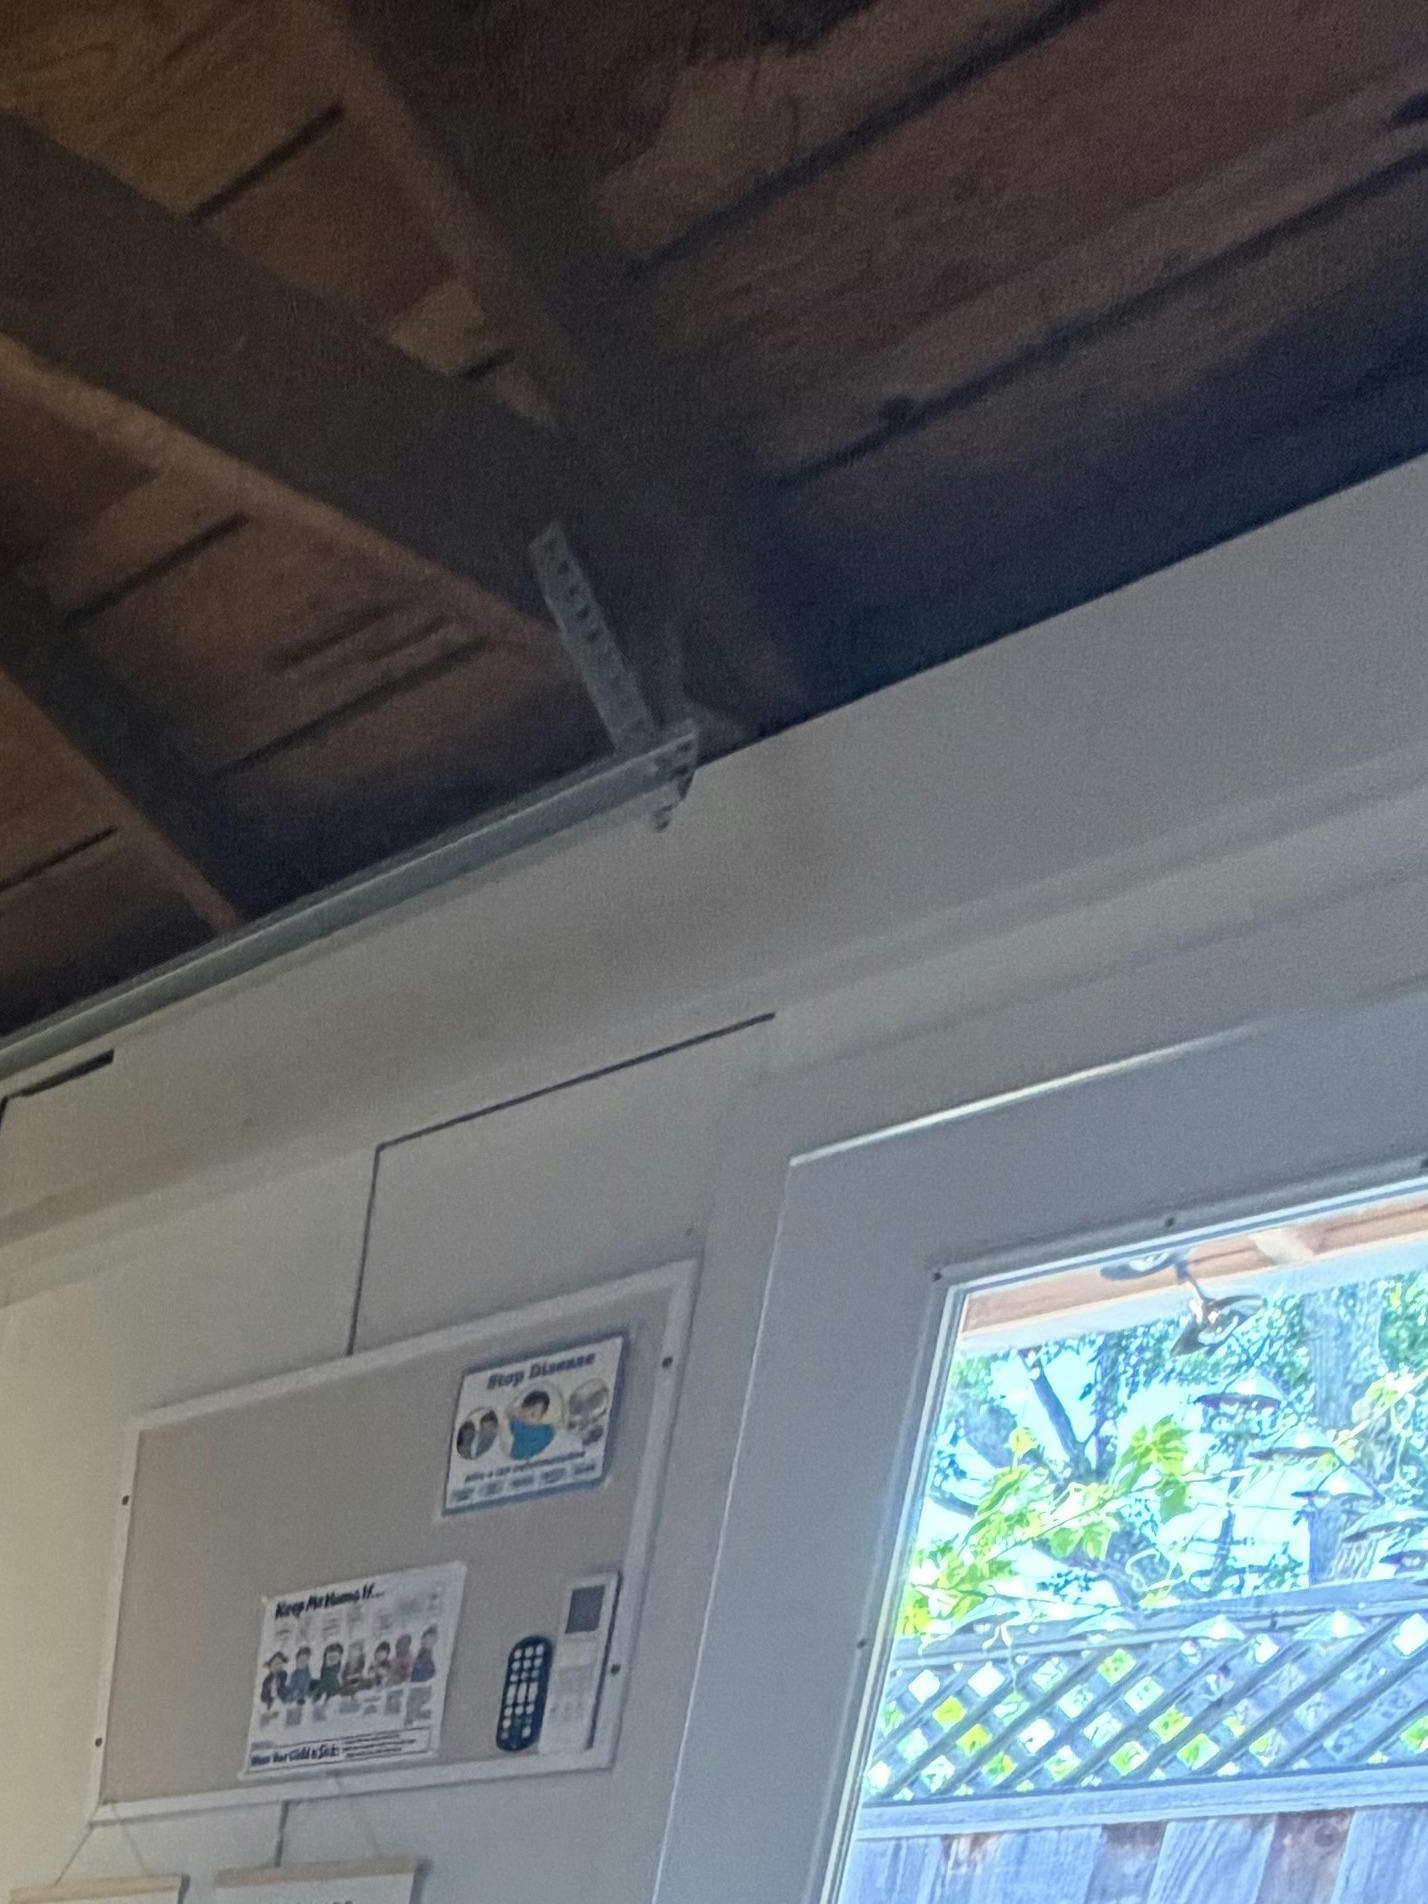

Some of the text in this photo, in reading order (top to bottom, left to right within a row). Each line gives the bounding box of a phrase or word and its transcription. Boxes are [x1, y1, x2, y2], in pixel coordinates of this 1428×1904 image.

[486, 1353, 596, 1390] Stop Disease
[275, 1602, 305, 1620] Keep
